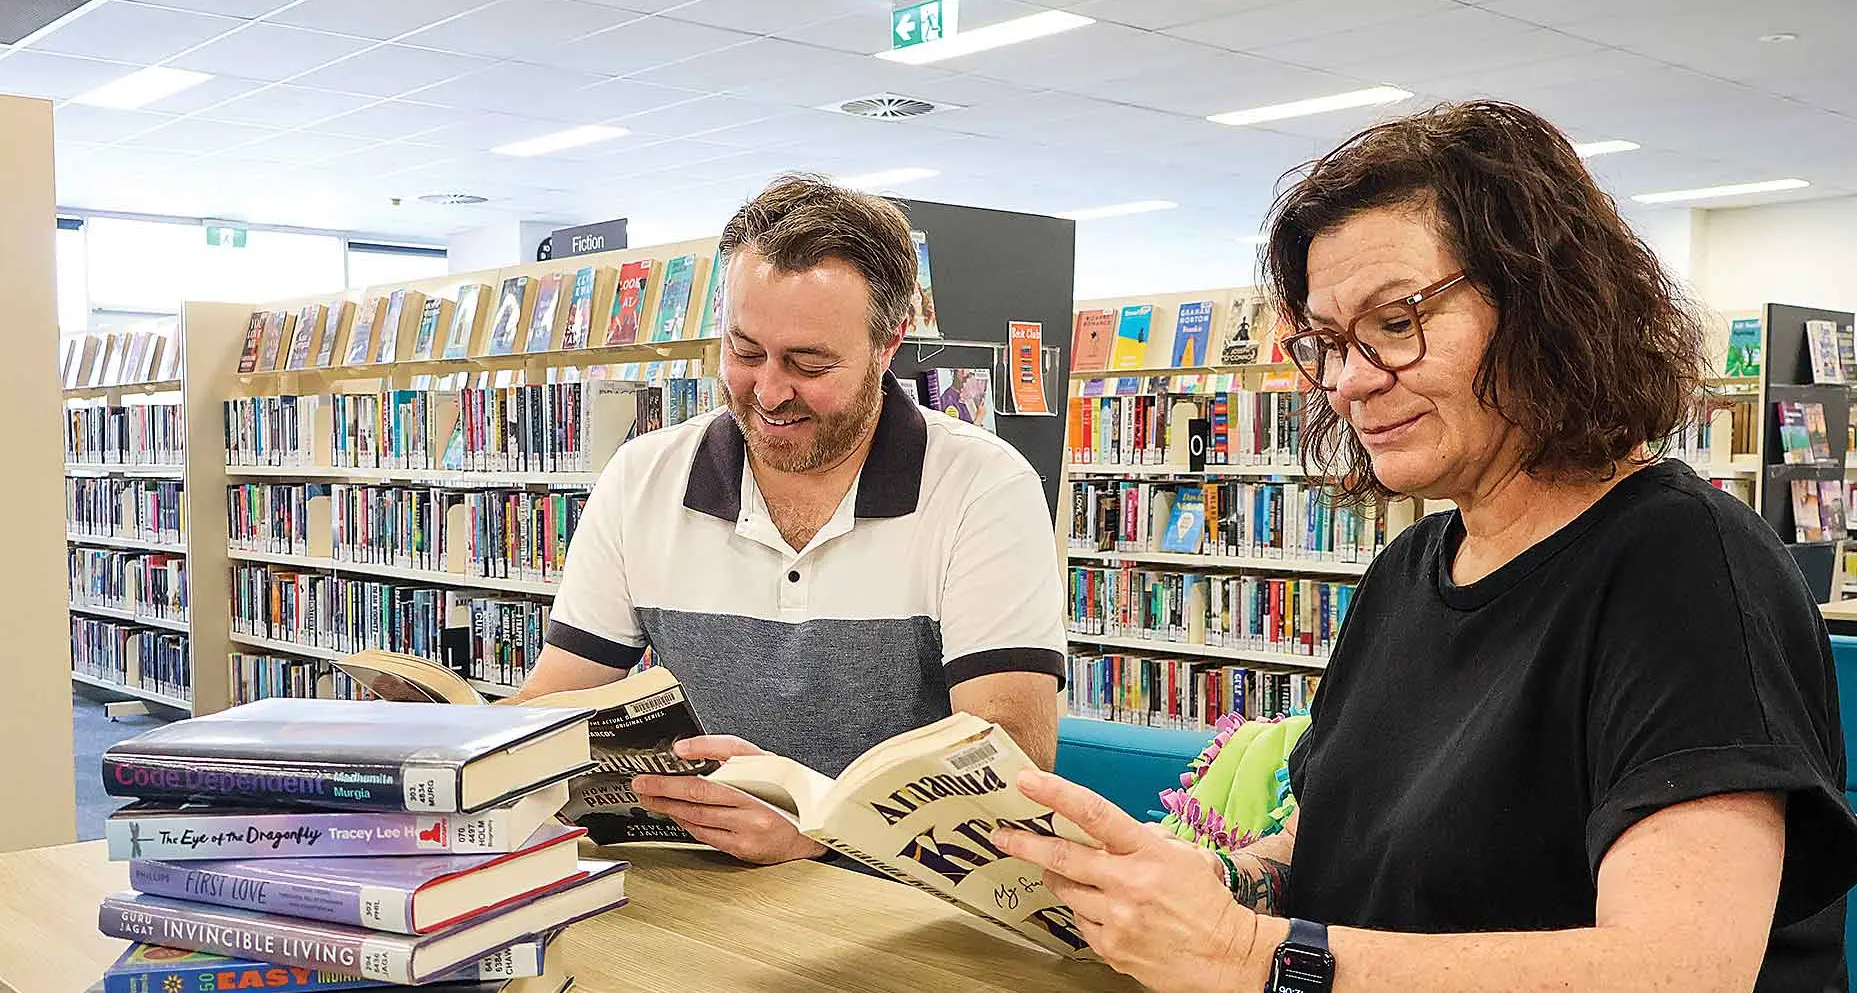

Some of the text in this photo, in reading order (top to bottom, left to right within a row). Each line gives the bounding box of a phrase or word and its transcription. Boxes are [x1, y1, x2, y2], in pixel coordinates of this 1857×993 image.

[572, 234, 604, 253] Fiction
[475, 612, 483, 638] CULT
[602, 716, 624, 726] ACTUAL
[615, 719, 643, 729] ORIGINAL
[588, 730, 616, 738] ARCOS
[113, 762, 324, 796] Code Dependent
[333, 772, 394, 784] Madhumita
[333, 787, 371, 799] Murgia
[427, 779, 435, 807] MURG
[582, 782, 632, 797] HOW WE
[583, 791, 640, 808] PABLO
[159, 826, 322, 849] The Eye of the Dragonfly
[328, 826, 373, 842] Tracey
[376, 826, 401, 840] Lee
[457, 827, 466, 843] 070
[467, 823, 476, 844] 4497
[477, 819, 486, 846] HOLM
[626, 824, 664, 832] STEVE
[185, 870, 226, 898] FIRST
[232, 876, 270, 904] LOVE
[993, 884, 1018, 910] My
[121, 910, 153, 925] GURU
[373, 899, 381, 921] PHIL
[119, 923, 154, 936] JAGAT
[163, 918, 354, 966] INVINCIBLE LIVING
[381, 951, 390, 978] JAGA
[484, 957, 493, 972] 641
[503, 947, 513, 976] CHAW
[199, 972, 215, 992] 50
[216, 967, 312, 991] EASY
